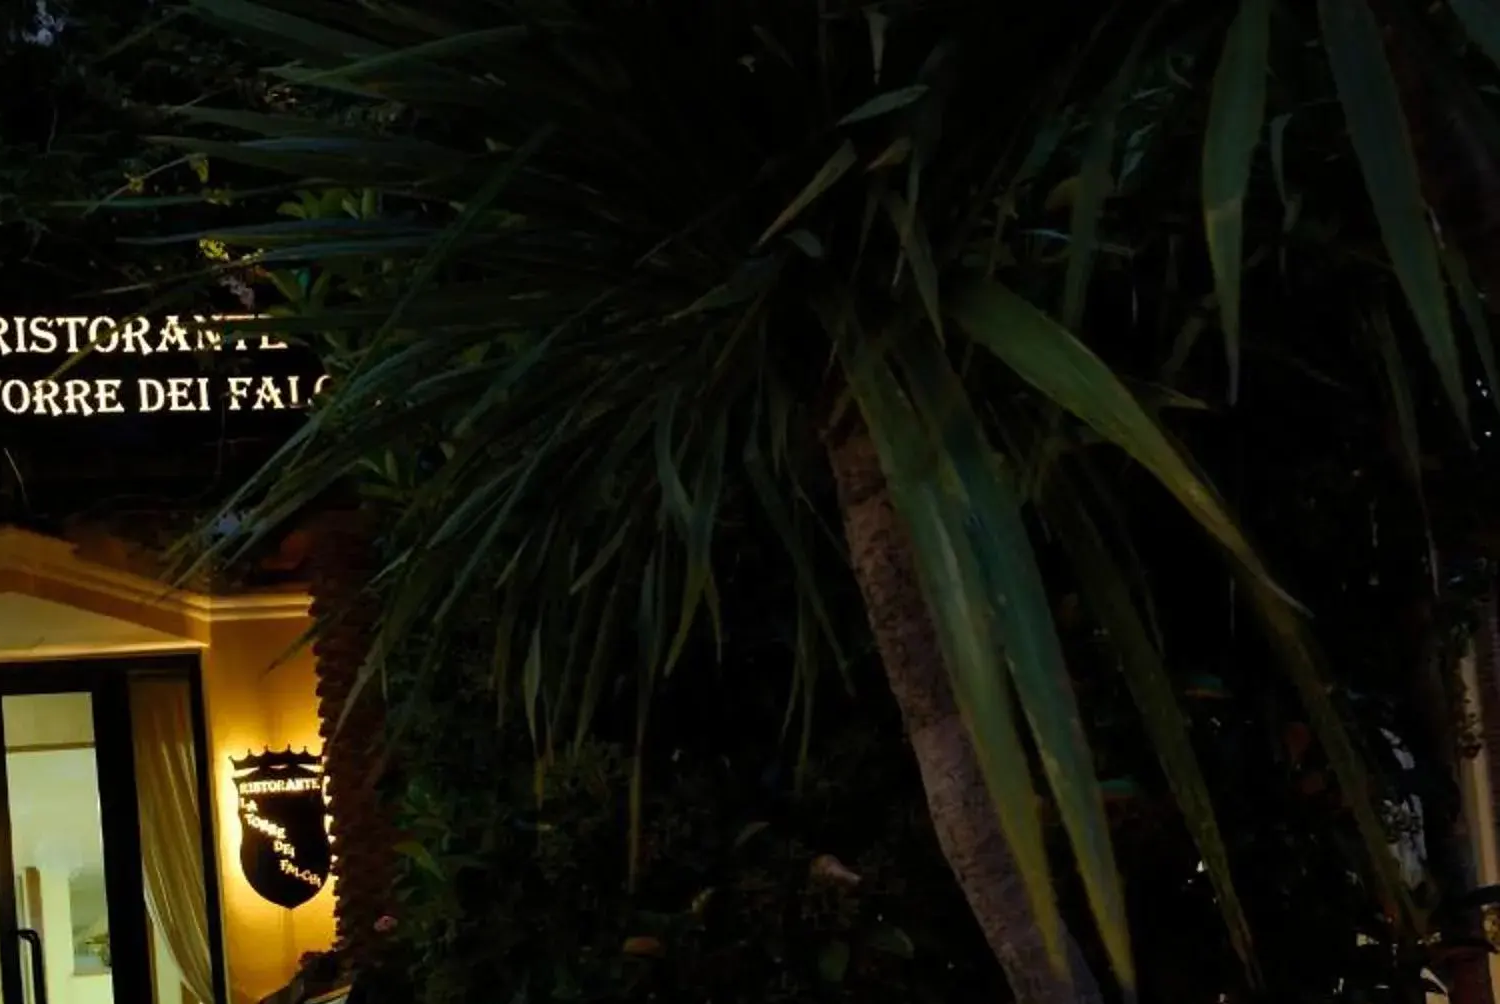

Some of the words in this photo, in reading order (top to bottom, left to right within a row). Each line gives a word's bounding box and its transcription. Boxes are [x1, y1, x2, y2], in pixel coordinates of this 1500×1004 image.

[138, 375, 212, 414] DEI
[239, 778, 321, 795] RISTORANTE
[239, 796, 258, 812] LA
[243, 813, 287, 839] TORRE
[273, 840, 296, 858] DEI
